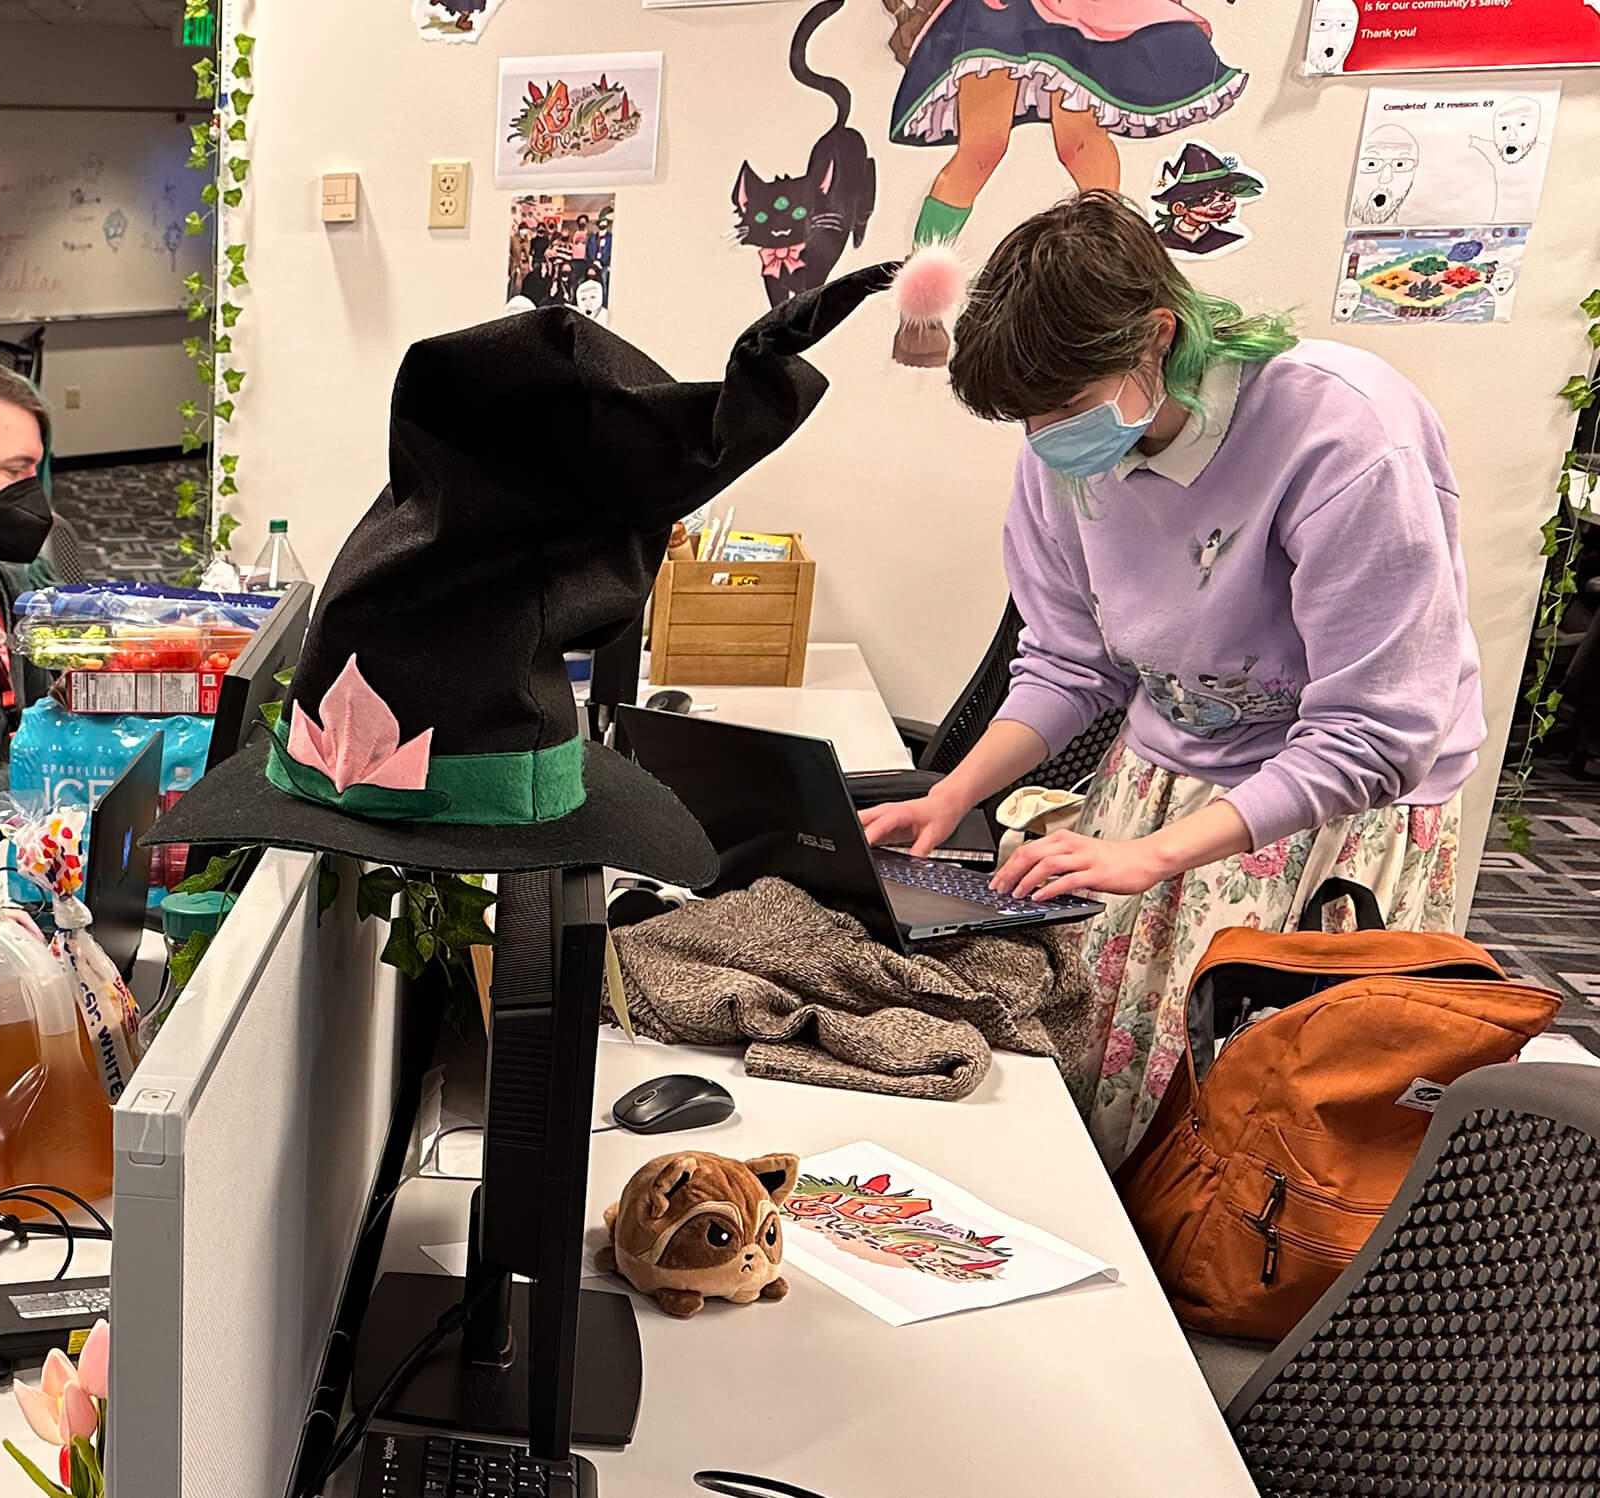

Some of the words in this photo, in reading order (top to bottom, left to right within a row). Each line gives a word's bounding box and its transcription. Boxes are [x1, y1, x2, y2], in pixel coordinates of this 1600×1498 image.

[1375, 1, 1390, 10] for
[1391, 2, 1410, 10] our
[1411, 0, 1476, 9] community's
[1361, 28, 1392, 39] Thank
[1393, 27, 1417, 39] you!
[1383, 102, 1427, 111] Completed
[1482, 100, 1494, 108] 69
[41, 763, 116, 777] SPARKLING
[98, 1024, 125, 1098] WHITE
